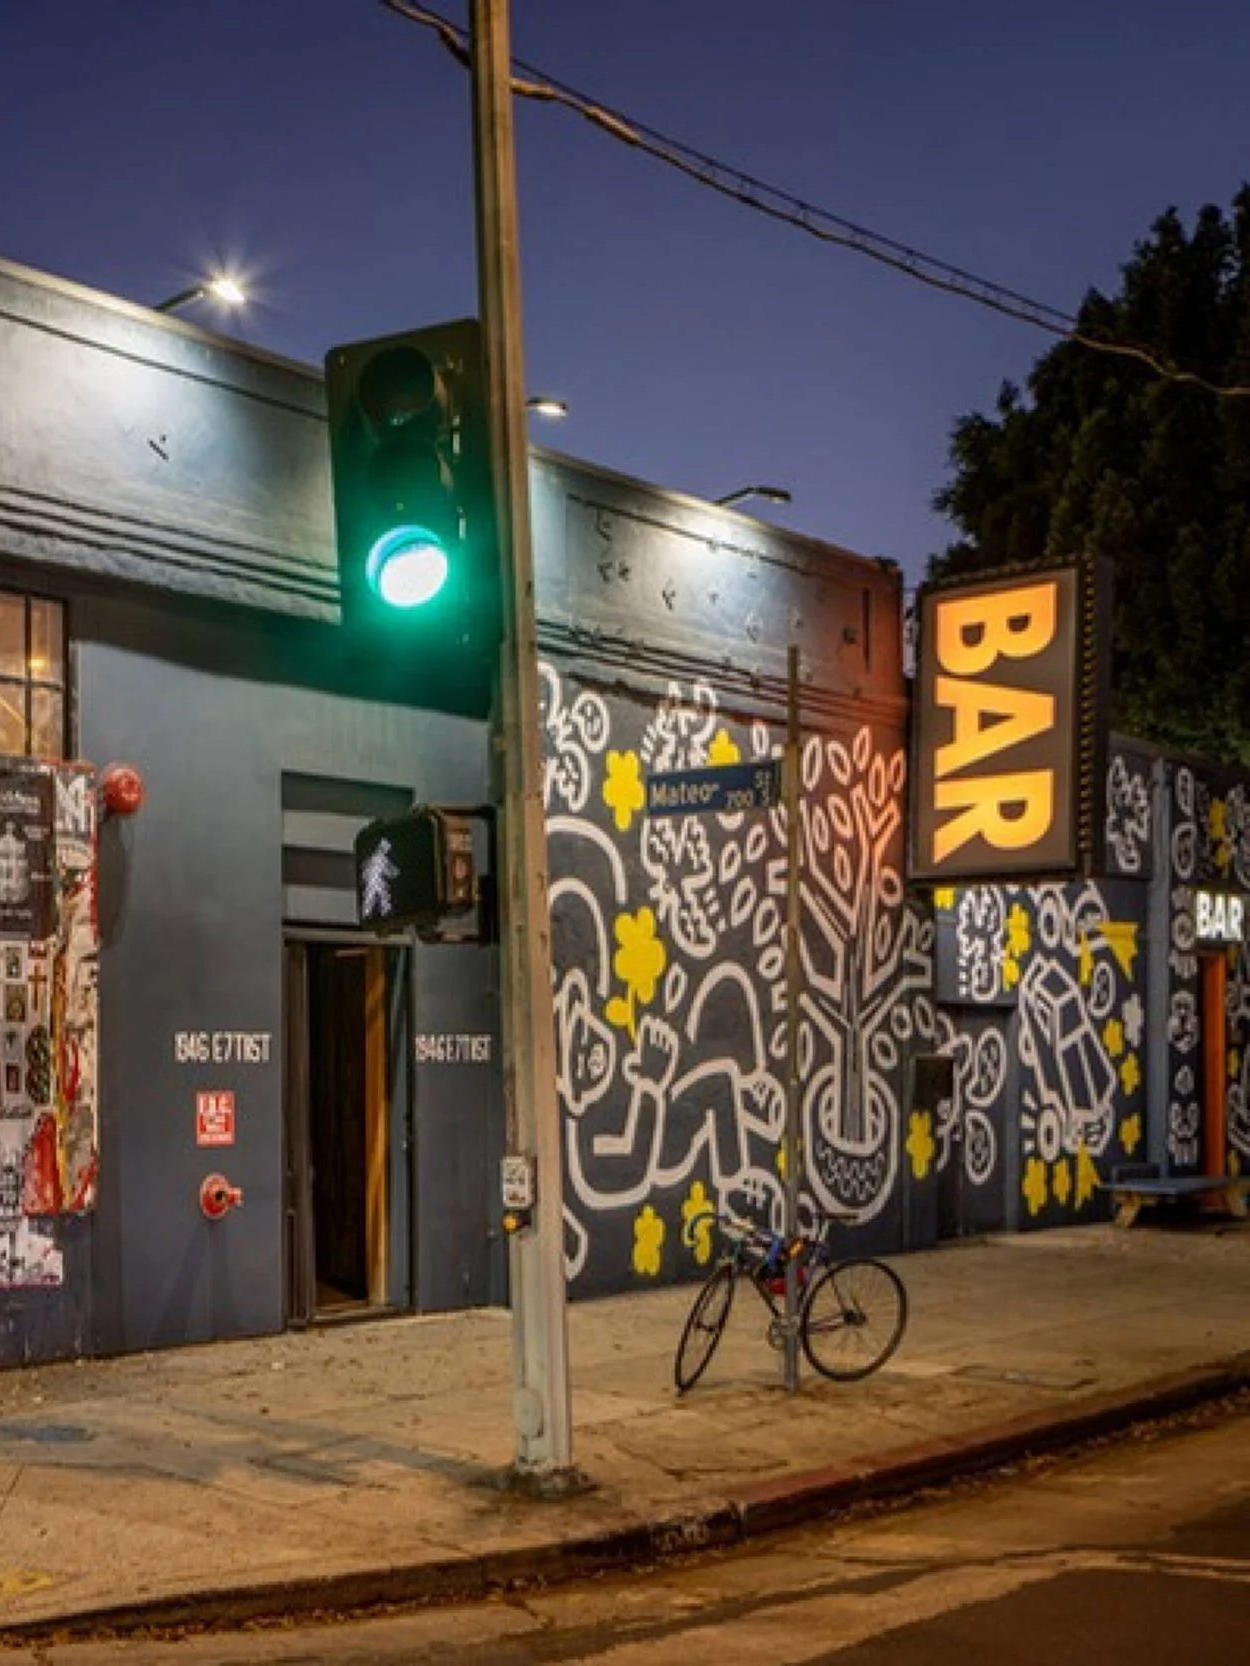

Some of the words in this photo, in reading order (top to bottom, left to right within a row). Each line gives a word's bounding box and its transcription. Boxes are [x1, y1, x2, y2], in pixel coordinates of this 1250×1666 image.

[933, 580, 1058, 865] BAR
[650, 781, 713, 807] Mateo
[1196, 890, 1244, 941] BAR
